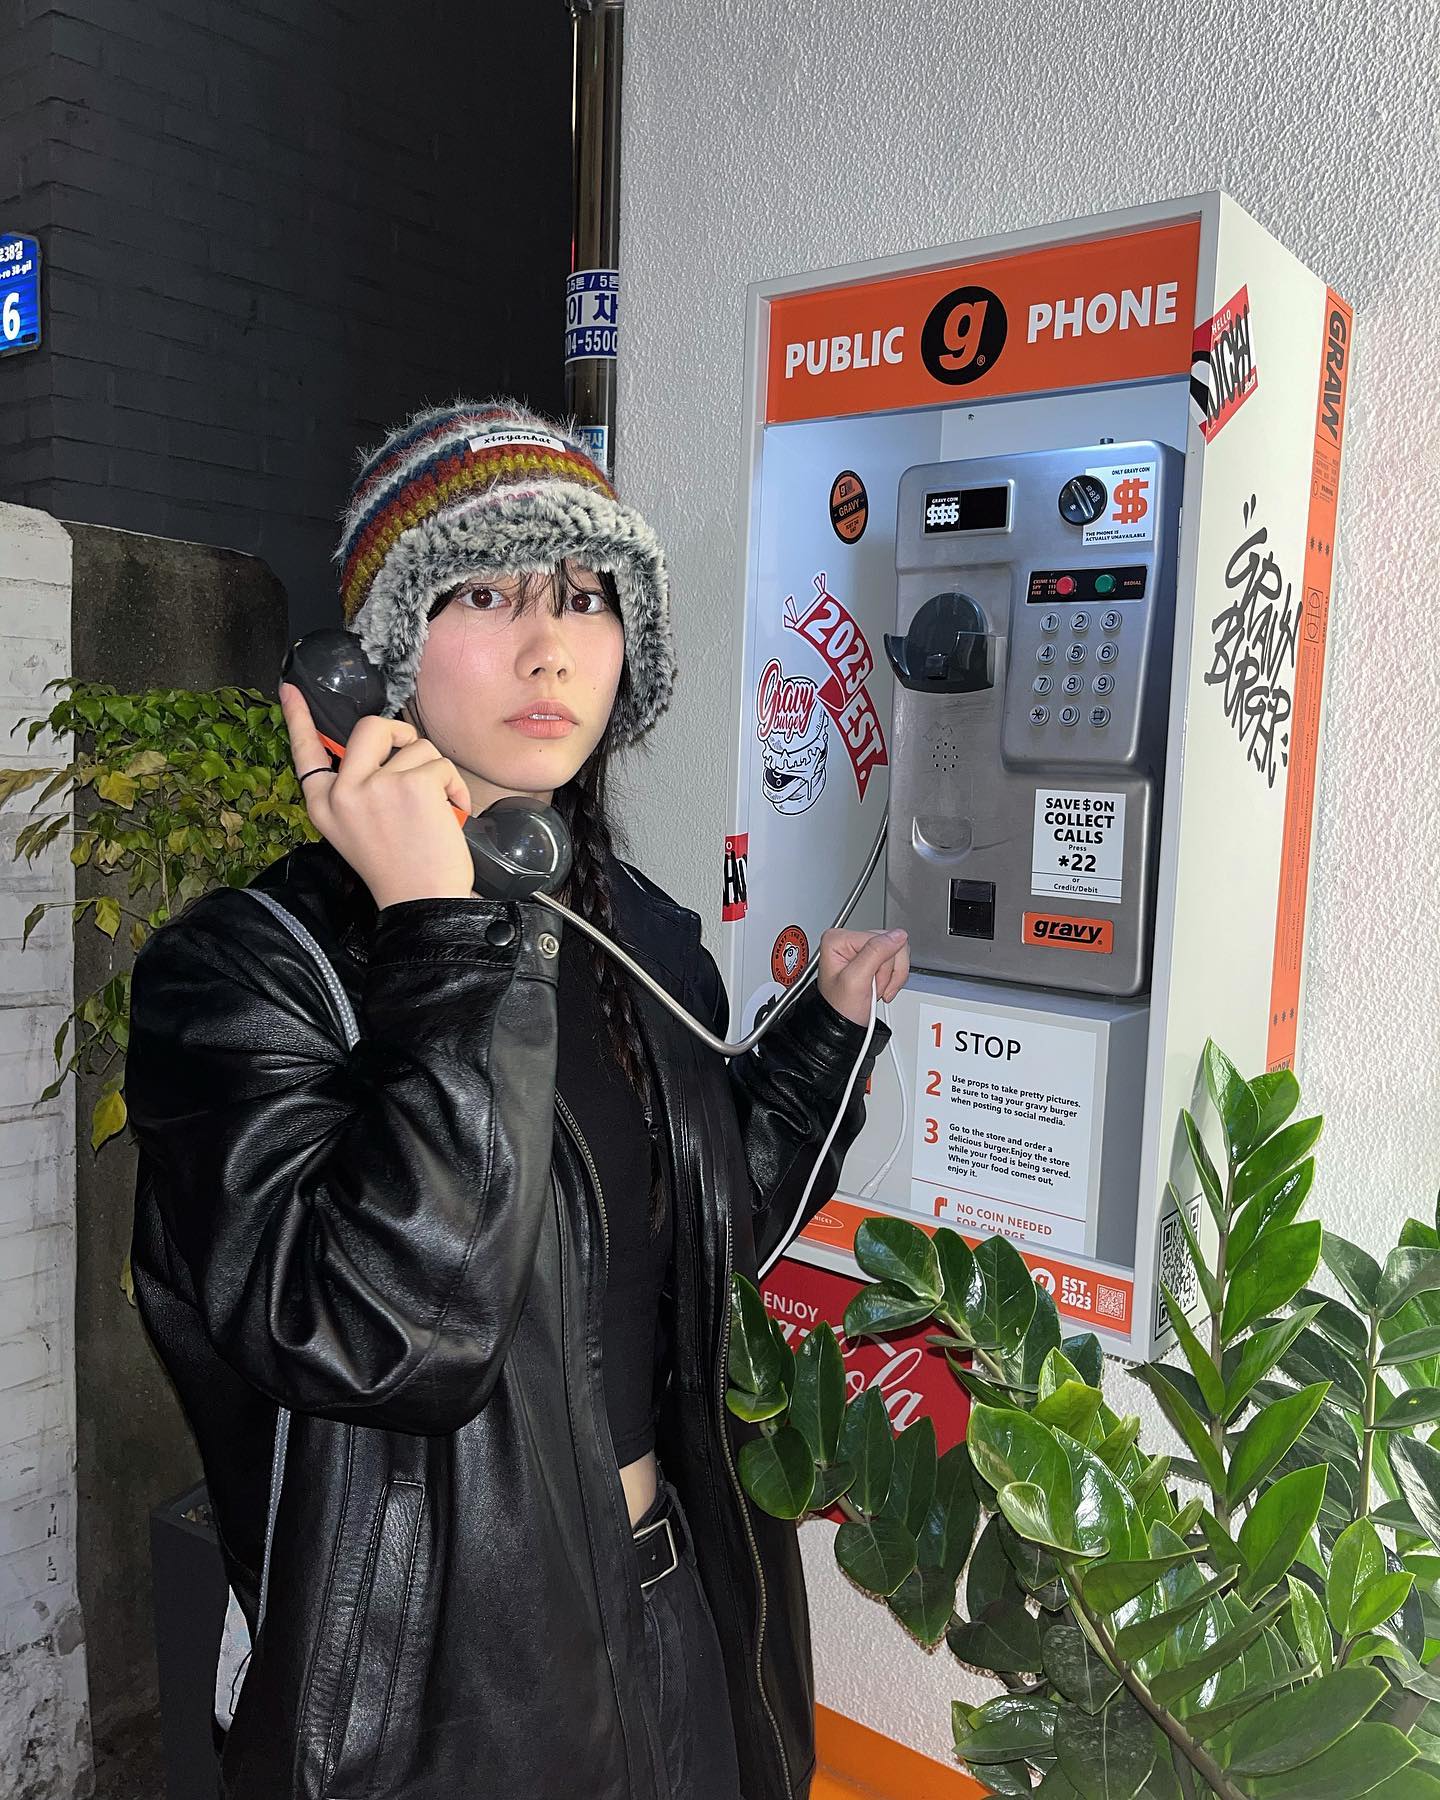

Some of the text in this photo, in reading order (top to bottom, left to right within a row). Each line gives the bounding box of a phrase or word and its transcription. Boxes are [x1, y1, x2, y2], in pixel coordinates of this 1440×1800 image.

[3, 292, 21, 340] 6
[1211, 309, 1232, 335] HELLO
[785, 326, 904, 379] PUBLIC
[1027, 281, 1178, 344] PHONE
[838, 498, 860, 517] GRAVY
[1111, 532, 1146, 540] UNAVAILABLE
[1047, 616, 1052, 628] 1
[1074, 615, 1085, 628] 2
[1105, 613, 1115, 627] 3
[803, 600, 870, 694] 2023
[1041, 646, 1050, 659] 4
[1071, 646, 1080, 659] 5
[1101, 645, 1111, 659] 6
[1038, 677, 1047, 690] 7
[1066, 677, 1076, 690] 8
[1097, 677, 1107, 690] 9
[1062, 708, 1072, 721] 0
[838, 691, 884, 781] EST.
[1045, 797, 1081, 811] SAVE
[1093, 800, 1115, 812] ON
[1044, 812, 1115, 829] COLLECT
[1053, 829, 1104, 844] CALLS
[1068, 844, 1087, 852] Press
[1053, 883, 1098, 894] Credit/Debit
[1033, 919, 1103, 944] gravy
[931, 1022, 1022, 1061] 1 STOP
[925, 1070, 942, 1097] 2
[952, 1075, 966, 1084] Use
[967, 1079, 989, 1089] props
[1001, 1085, 1018, 1095] take
[1020, 1090, 1045, 1102] pretty
[1046, 1094, 1081, 1108] pictures.
[950, 1096, 1066, 1127] when posting to social media.
[951, 1085, 961, 1093] Be
[962, 1088, 979, 1097] sure
[991, 1094, 1003, 1104] tag
[1005, 1097, 1024, 1107] your
[1025, 1102, 1048, 1113] gravy
[1049, 1105, 1078, 1118] burger
[924, 1118, 939, 1144] 3
[949, 1123, 960, 1132] Go
[961, 1126, 970, 1134] to
[971, 1128, 985, 1137] the
[986, 1132, 1006, 1142] store
[1007, 1137, 1022, 1146] and
[1024, 1140, 1046, 1151] order
[948, 1133, 982, 1147] delicious
[1034, 1153, 1048, 1162] the
[1049, 1157, 1070, 1168] store
[947, 1164, 968, 1177] enjoy
[948, 1144, 1071, 1179] while your food is being served.
[948, 1153, 970, 1165] When
[971, 1160, 989, 1170] your
[990, 1164, 1009, 1174] food
[1010, 1169, 1036, 1181] comes
[956, 1202, 1052, 1235] NO COIN NEEDED
[1061, 1275, 1092, 1297] EST.
[763, 1290, 819, 1323] ENJOY
[1060, 1290, 1092, 1311] 2023
